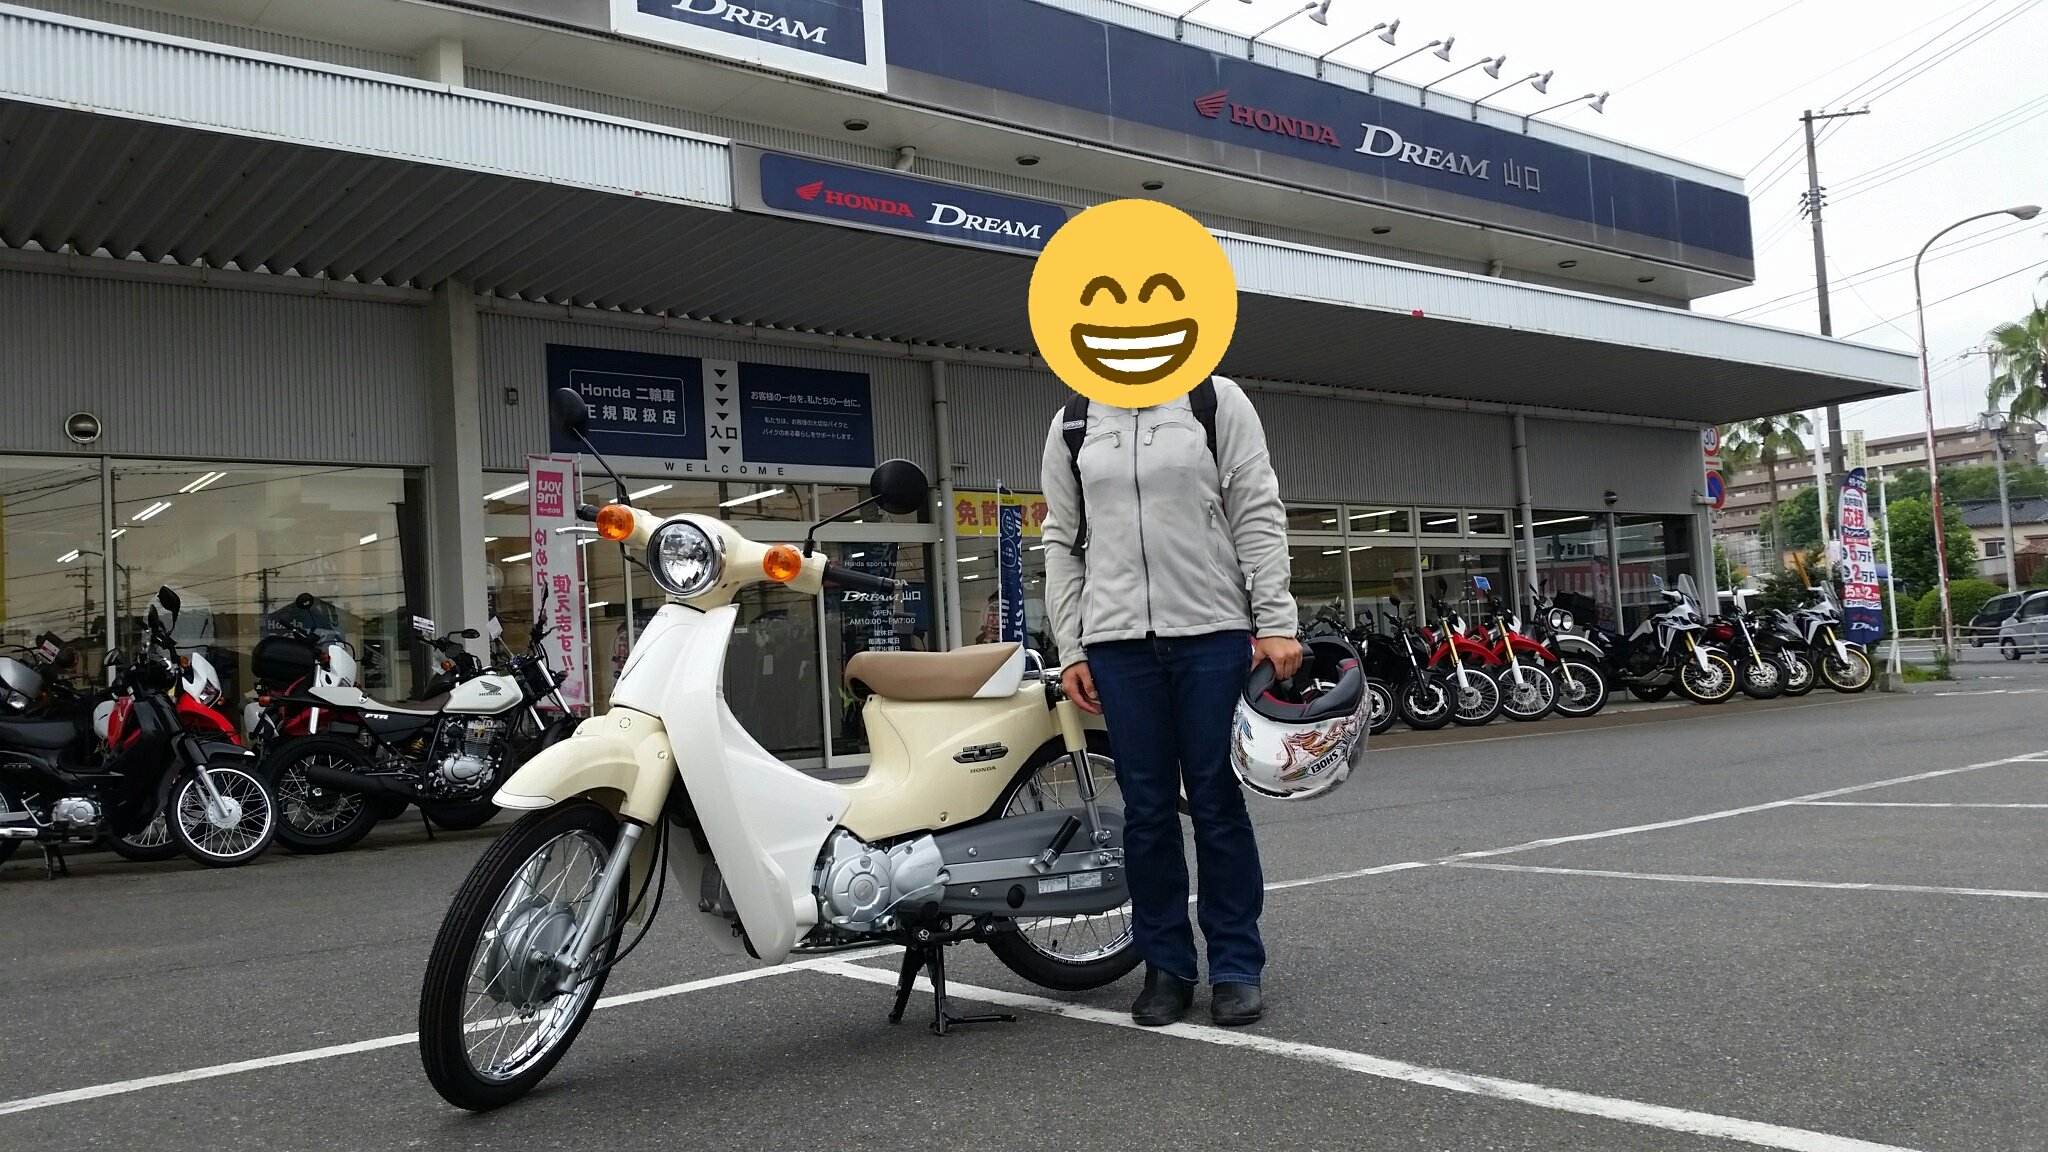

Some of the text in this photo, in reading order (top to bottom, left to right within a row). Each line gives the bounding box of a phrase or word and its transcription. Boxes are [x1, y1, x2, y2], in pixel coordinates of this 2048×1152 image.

[1229, 103, 1541, 193] HONDA DREAM 山口
[824, 189, 1042, 239] HONDA DREAM
[580, 382, 675, 403] Honda 二輪車
[710, 425, 738, 440] 入口
[665, 462, 784, 476] WELCOME
[841, 590, 921, 602] DREAM 山口
[970, 765, 996, 773] HONDA
[1310, 750, 1339, 773] SHOEI
